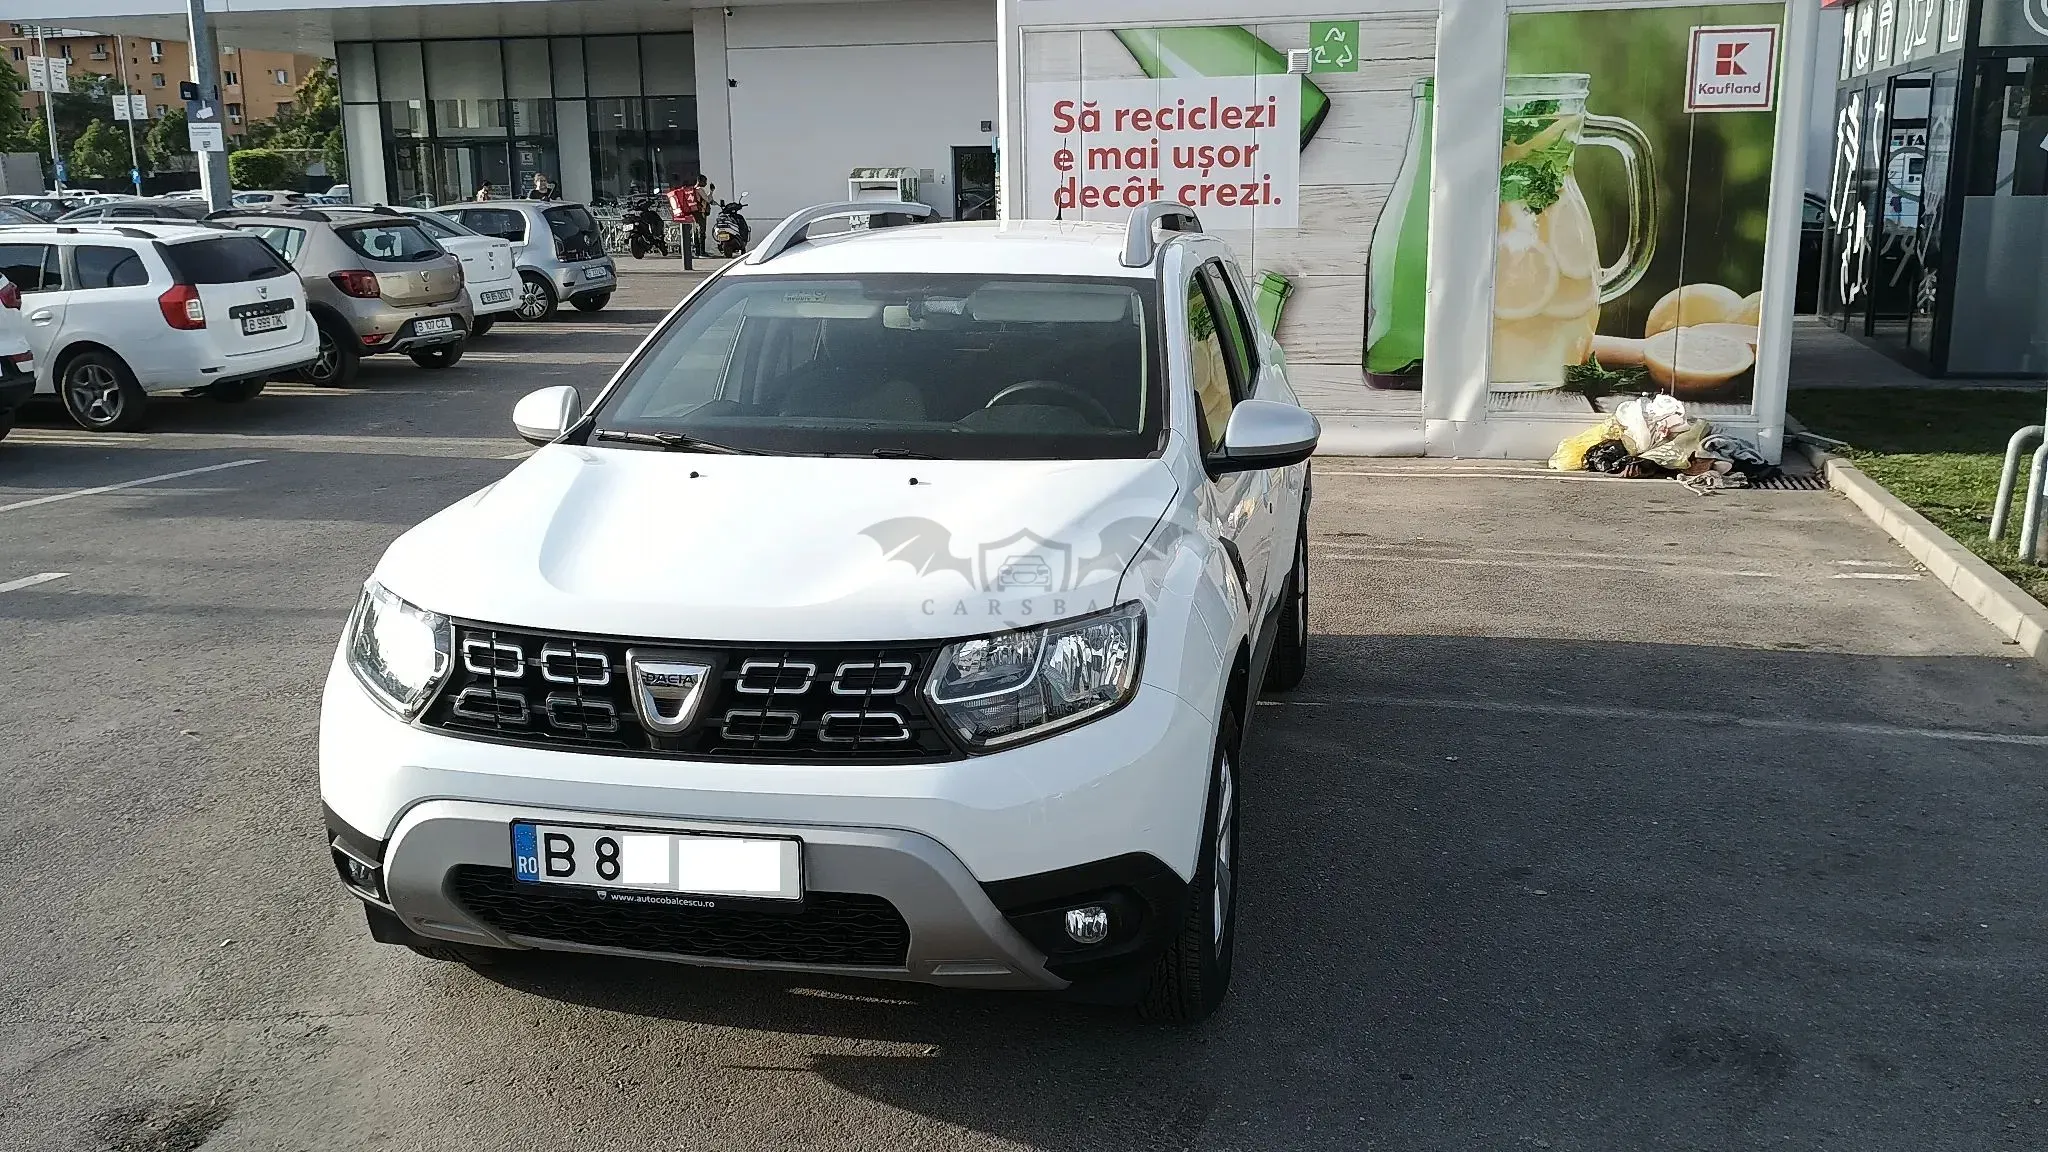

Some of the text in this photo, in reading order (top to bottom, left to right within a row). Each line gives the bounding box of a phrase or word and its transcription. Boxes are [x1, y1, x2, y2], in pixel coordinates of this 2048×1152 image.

[1698, 82, 1761, 94] Kaufland
[1052, 96, 1277, 134] Să reciclezi
[1053, 138, 1260, 178] e mai ușor
[1053, 173, 1281, 210] decât crezi.
[646, 672, 695, 685] DACIA
[518, 856, 538, 874] RO
[544, 832, 576, 878] B
[611, 893, 715, 908] www.autocobalcescu.ro
